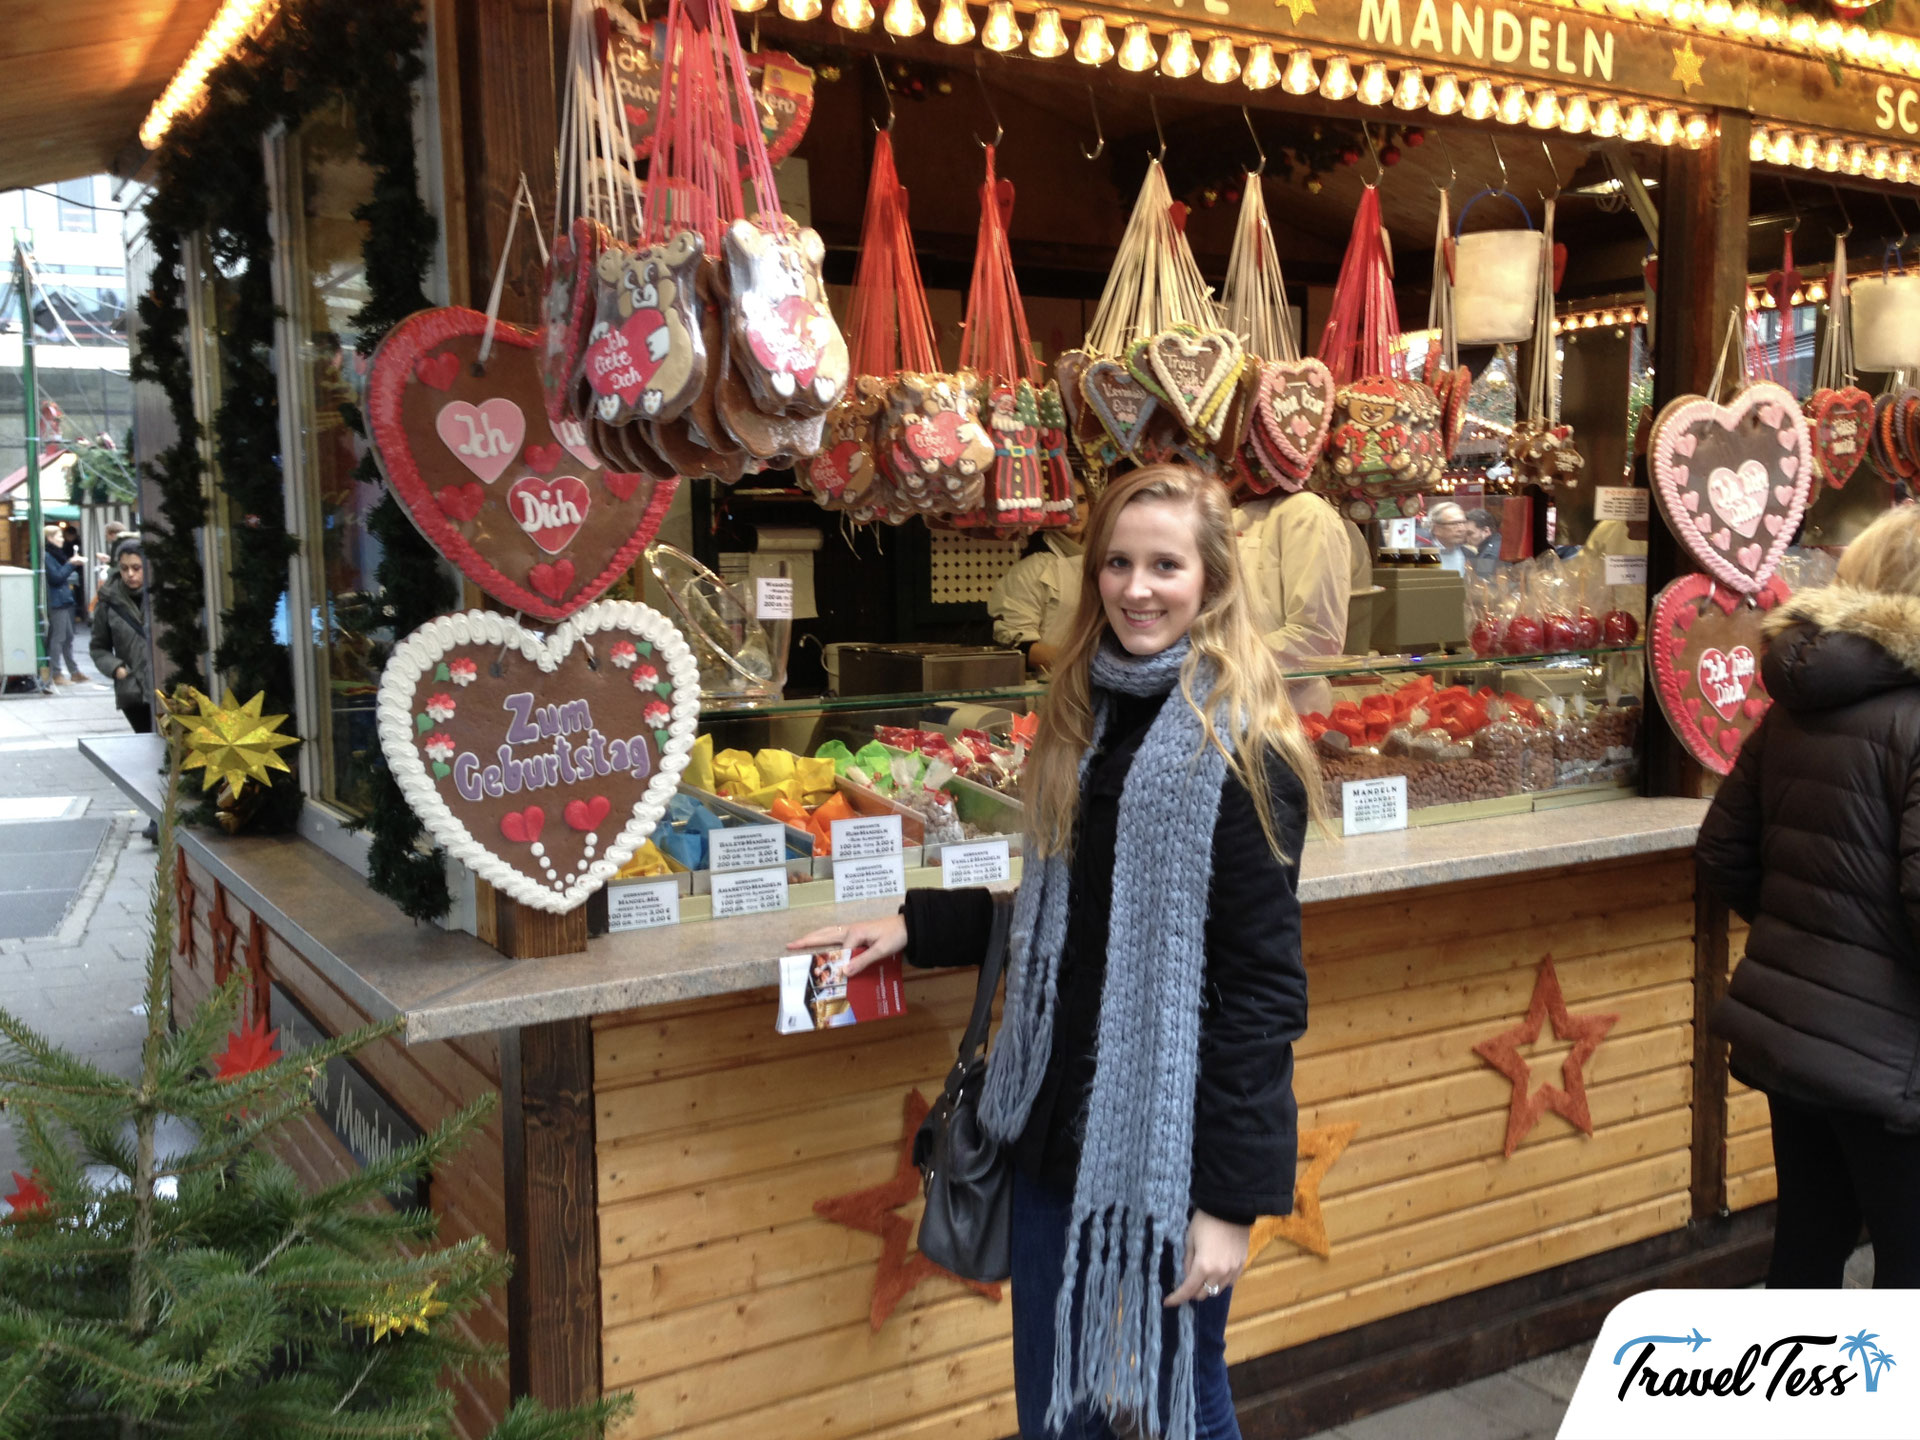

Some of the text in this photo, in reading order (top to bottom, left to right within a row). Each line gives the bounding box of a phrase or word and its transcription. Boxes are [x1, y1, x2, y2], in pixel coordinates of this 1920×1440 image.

[1358, 0, 1614, 81] MANDELN
[454, 412, 516, 458] Ich
[517, 489, 582, 533] Dich
[503, 692, 593, 744] Zum
[453, 728, 651, 801] Geburtstag
[1353, 786, 1397, 796] MANDELN
